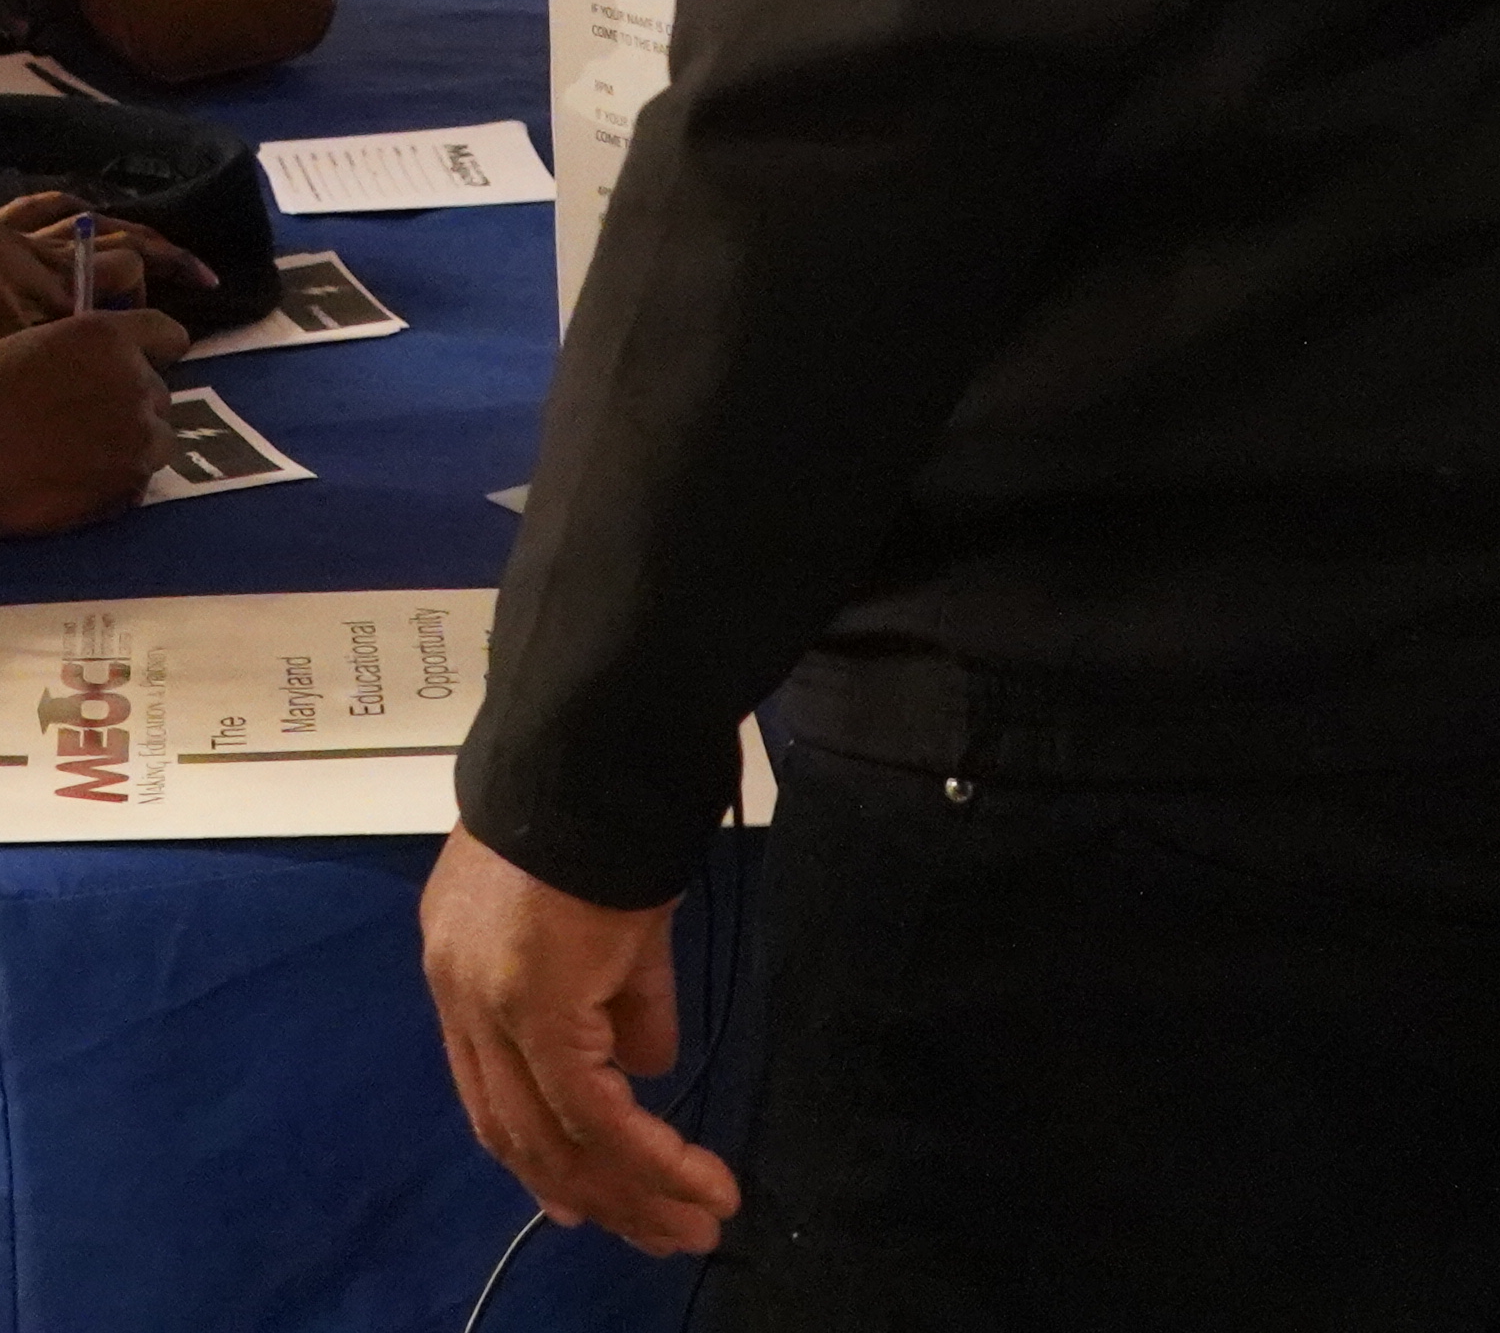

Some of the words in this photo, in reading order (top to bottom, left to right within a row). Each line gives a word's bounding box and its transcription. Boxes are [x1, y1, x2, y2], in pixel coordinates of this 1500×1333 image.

[280, 654, 322, 733] Maryland
[341, 619, 385, 717] Educational
[408, 606, 453, 701] Opportunity
[53, 661, 132, 804] MEOC
[210, 715, 246, 750] The
